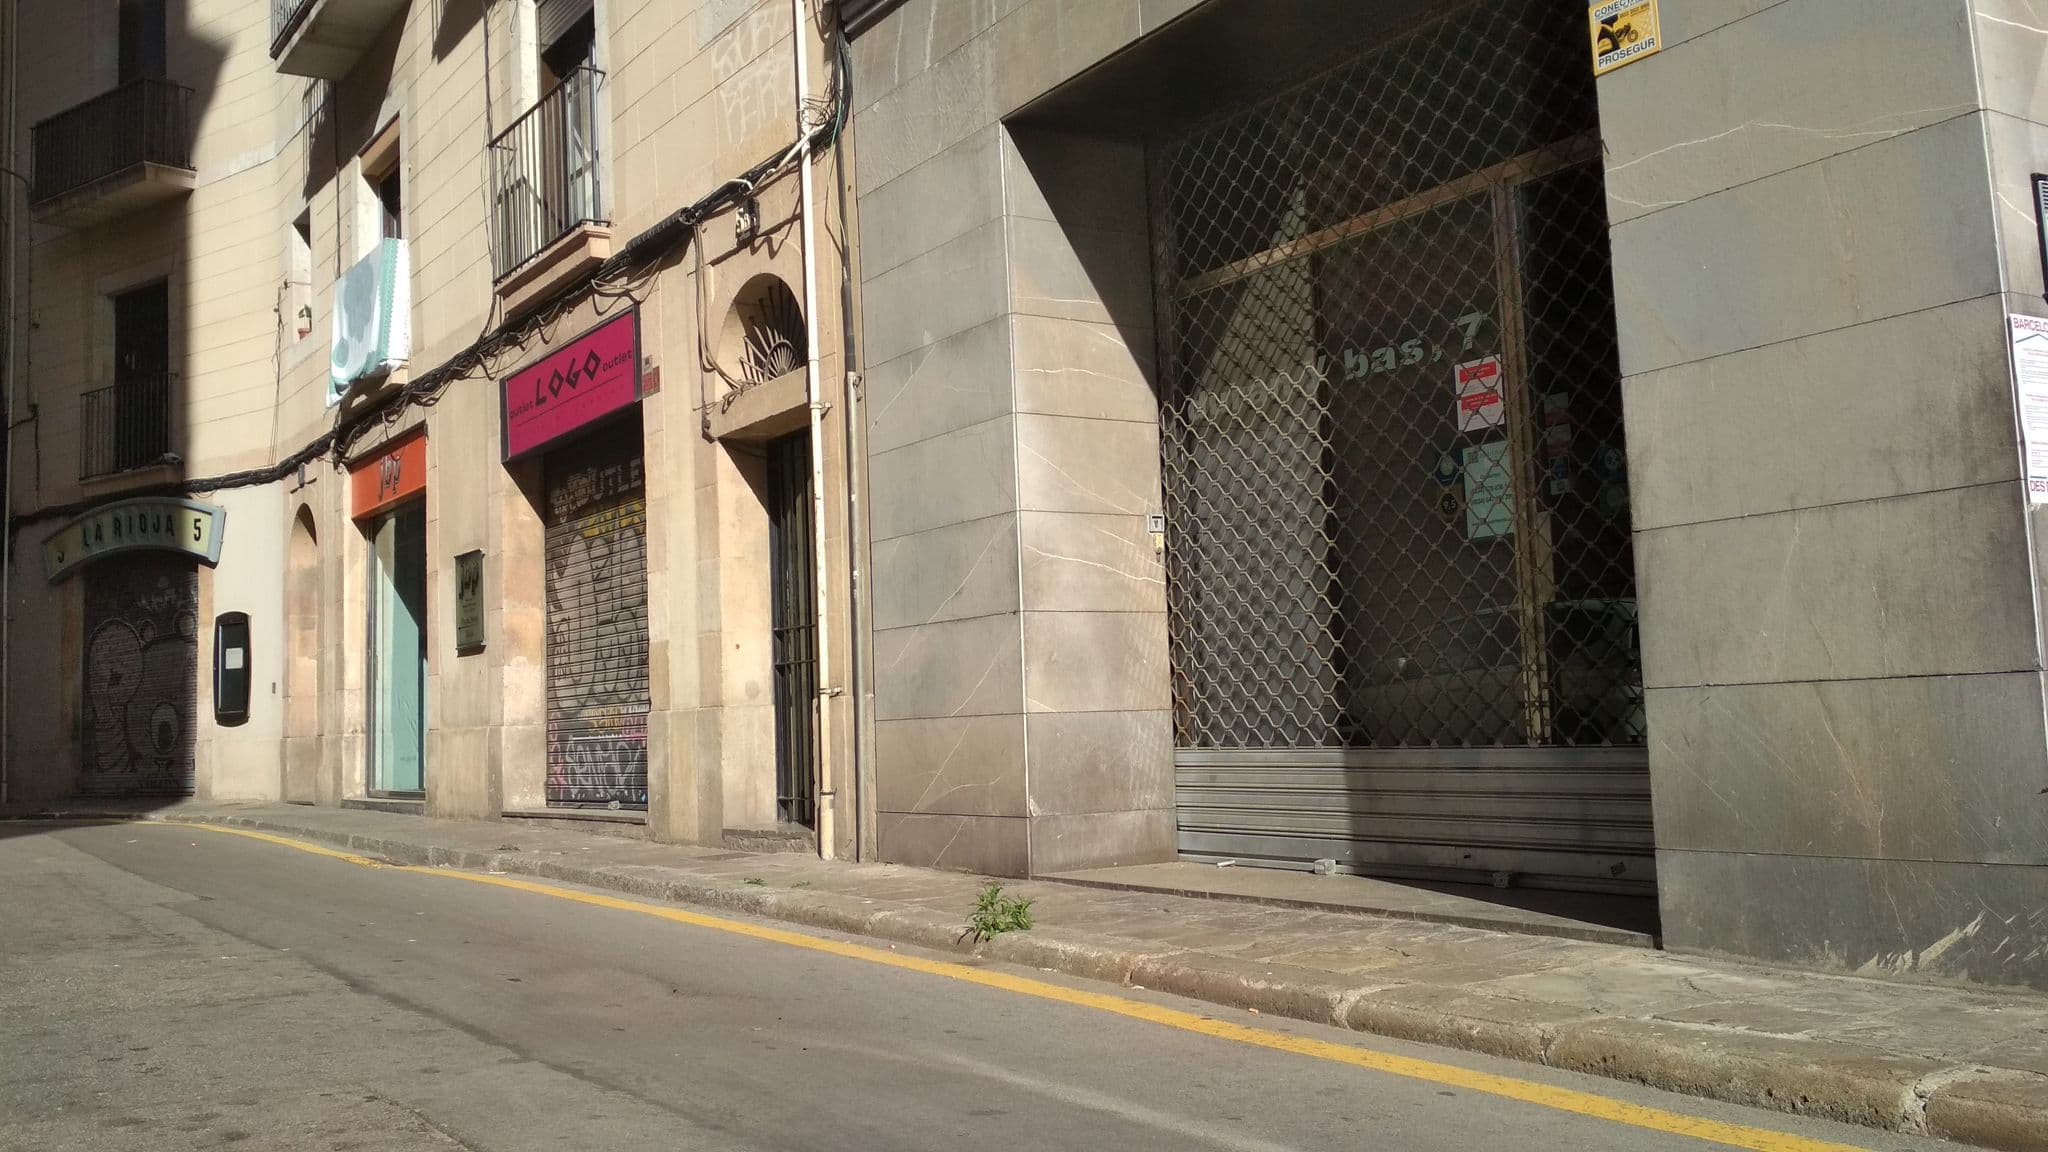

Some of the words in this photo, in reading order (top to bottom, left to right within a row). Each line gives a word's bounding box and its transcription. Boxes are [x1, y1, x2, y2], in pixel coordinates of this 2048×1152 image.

[1598, 37, 1656, 68] PROSEGUR
[1455, 311, 1484, 351] 7
[535, 349, 601, 407] LOGO
[602, 350, 633, 372] outlet
[2030, 480, 2047, 492] DES
[83, 522, 103, 547] LA
[113, 512, 175, 538] RIOJA
[193, 518, 202, 541] 5
